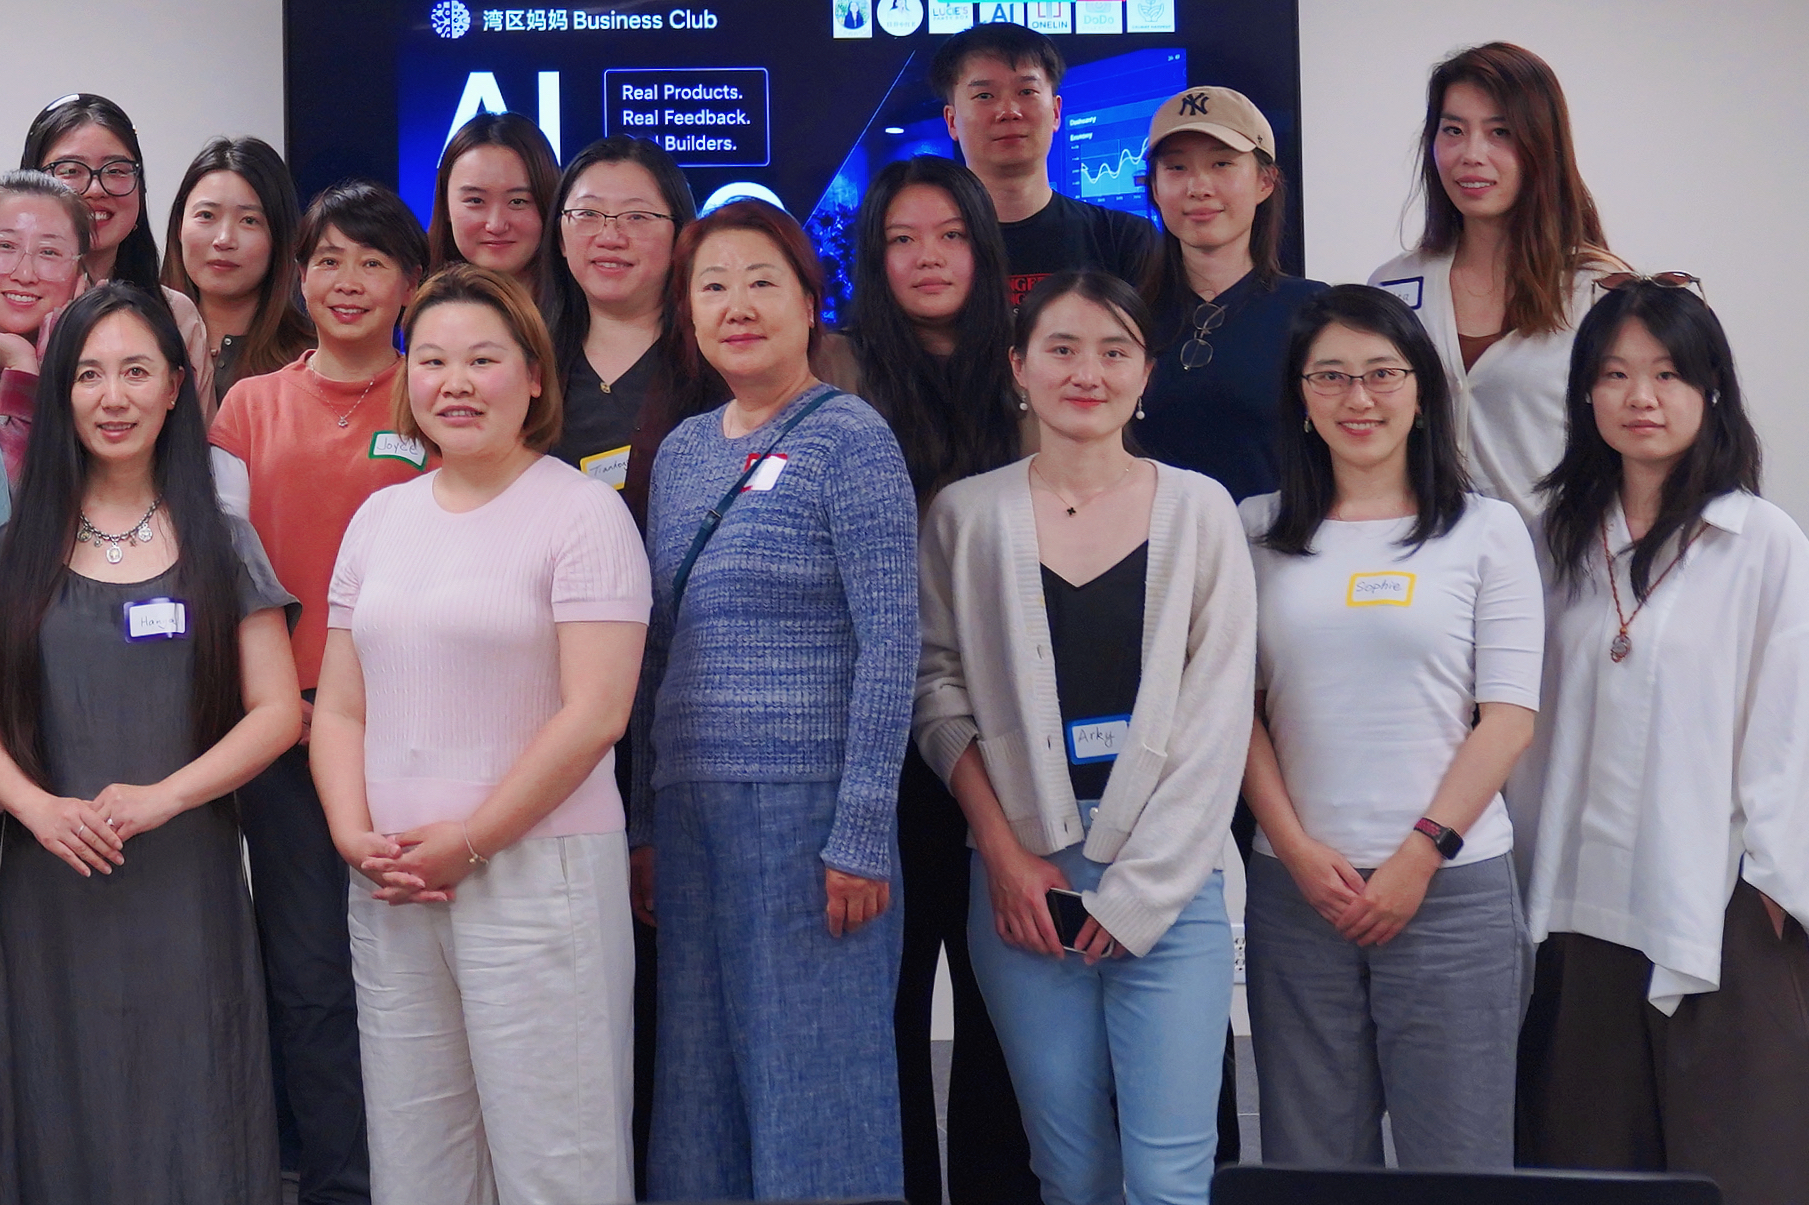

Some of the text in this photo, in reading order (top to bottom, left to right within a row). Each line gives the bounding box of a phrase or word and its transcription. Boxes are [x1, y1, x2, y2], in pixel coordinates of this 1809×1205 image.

[482, 9, 718, 32] 湾区妈妈 Business Club
[991, 3, 1014, 23] AI
[1083, 15, 1115, 25] DoDo
[622, 83, 743, 100] Real Products.
[437, 71, 561, 169] AI
[623, 109, 751, 126] Real Feedback.
[664, 134, 738, 152] Builders.
[376, 437, 418, 456] Joyce
[1355, 579, 1402, 594] Sophie
[1078, 726, 1115, 749] Arky
